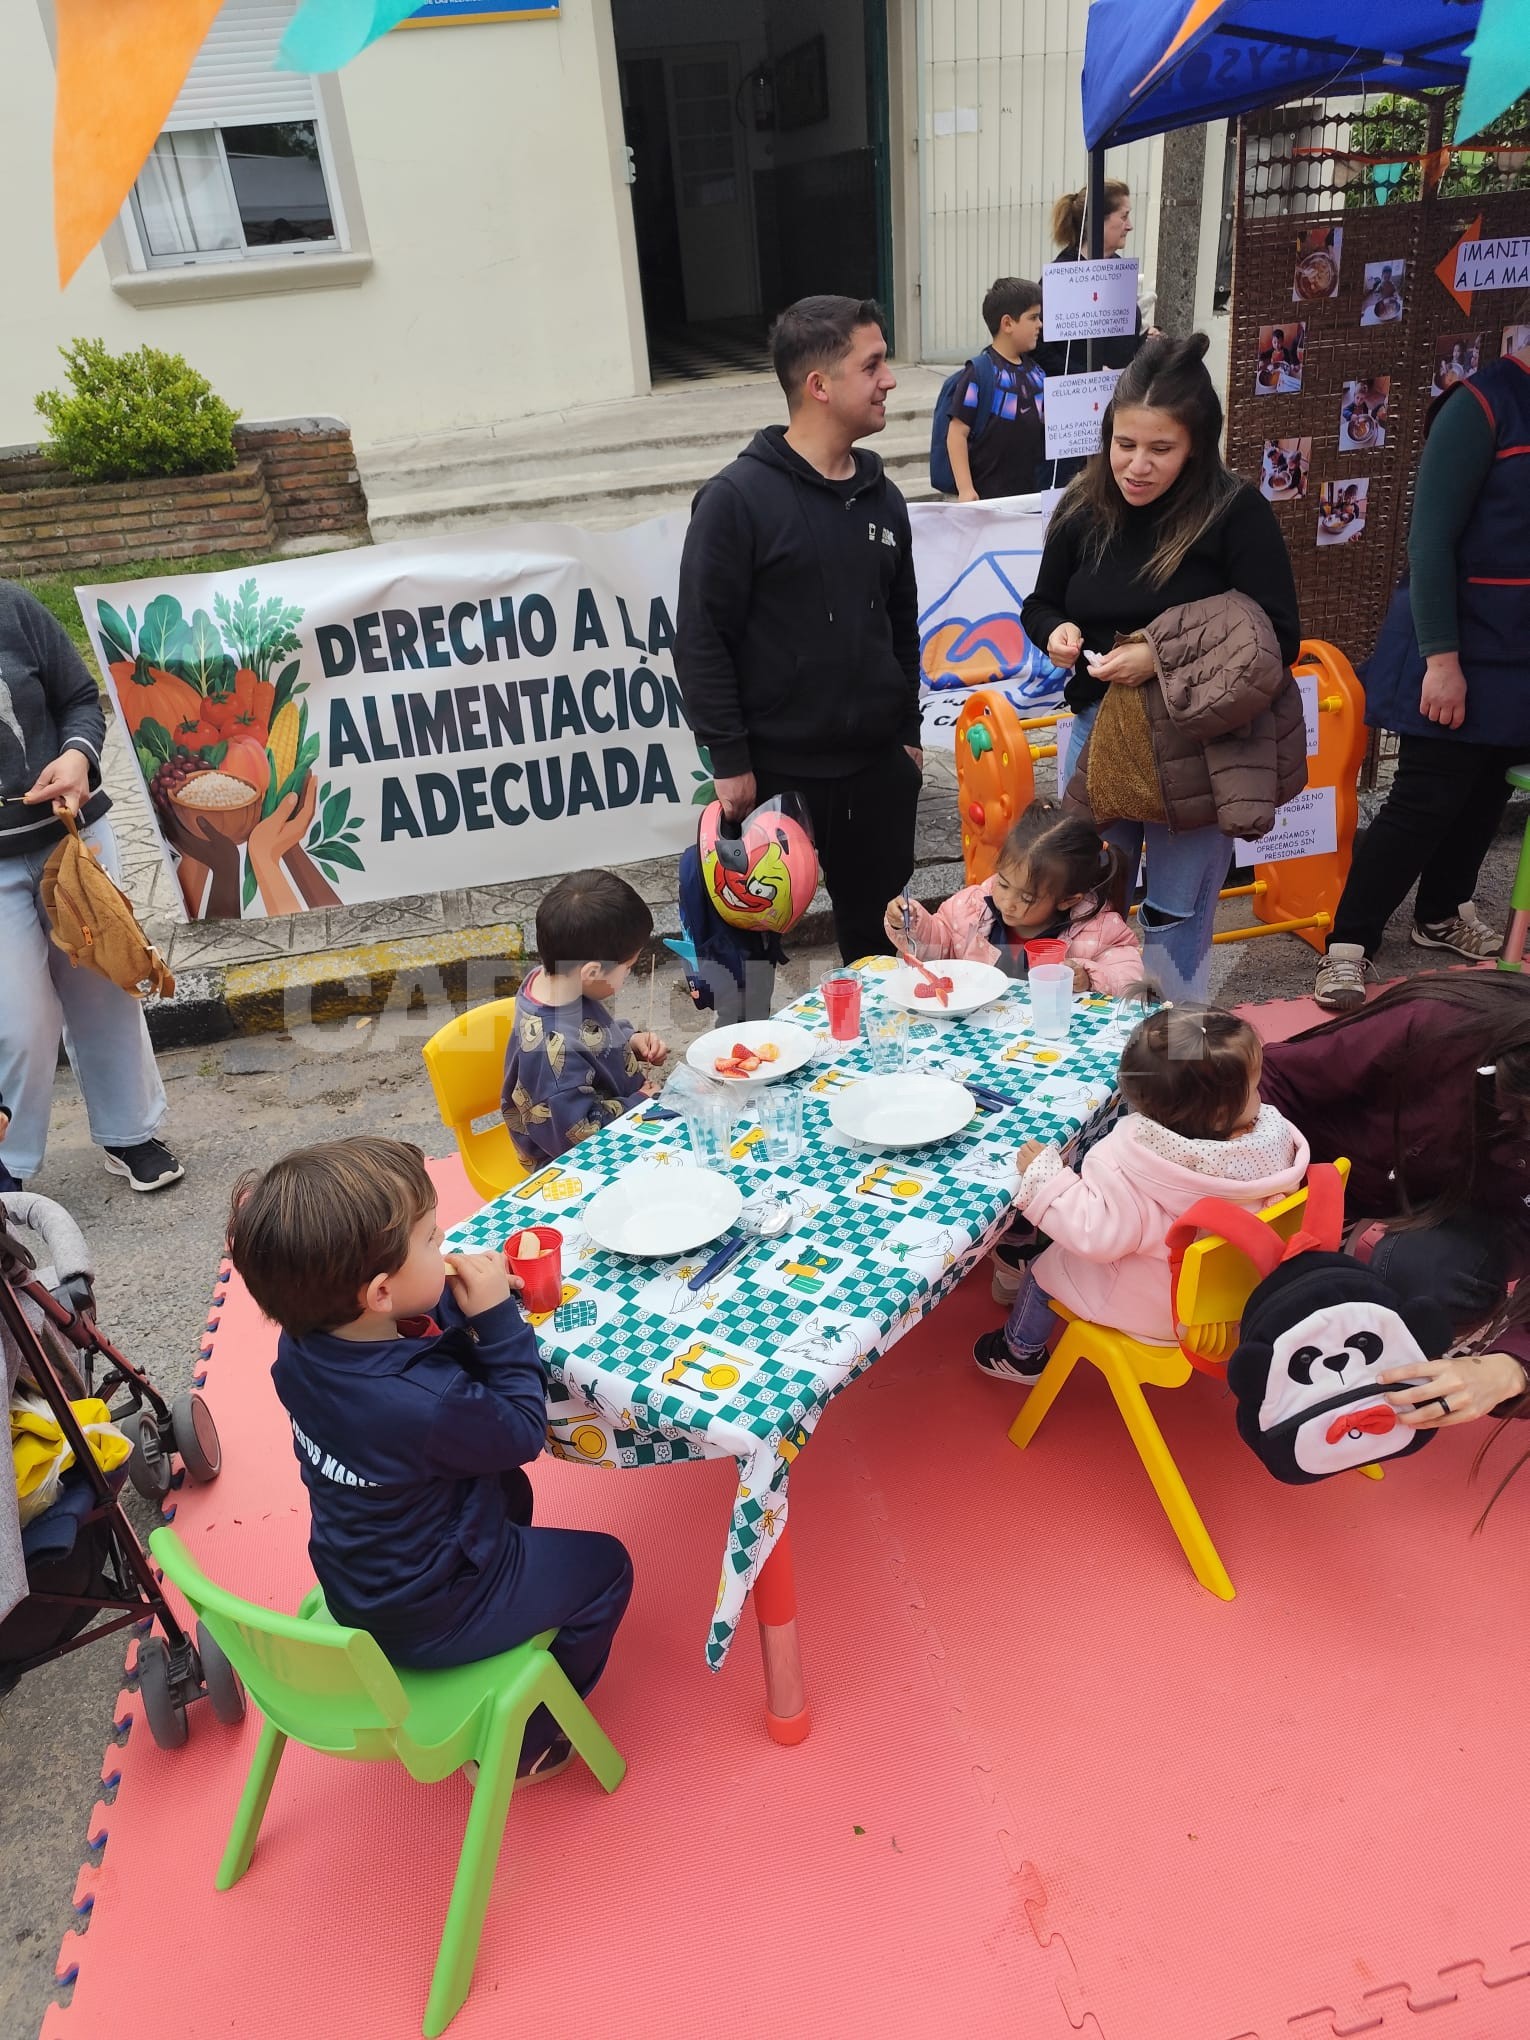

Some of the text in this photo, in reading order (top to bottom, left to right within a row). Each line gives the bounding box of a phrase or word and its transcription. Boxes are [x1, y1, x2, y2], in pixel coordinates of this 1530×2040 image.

[1092, 264, 1114, 273] COMER
[1115, 263, 1138, 271] MIRANDO
[1075, 275, 1089, 283] LOS
[1456, 271, 1467, 288] A
[1473, 269, 1496, 288] LA
[1066, 311, 1080, 320] LOS
[1082, 309, 1111, 319] ADULTOS
[1112, 308, 1130, 317] SOMOS
[1056, 317, 1129, 329] MODELOS IMPORTANTES
[1060, 329, 1077, 337] PARA
[1078, 327, 1101, 336] NIÑOS
[1088, 376, 1110, 384] MEJOR
[1052, 387, 1080, 397] CELULAR
[1082, 386, 1088, 394] O
[1061, 422, 1073, 430] LAS
[1059, 431, 1071, 439] LAS
[315, 587, 677, 679] DERECHO A LA
[328, 655, 695, 768] ALIMENTACIÓN
[380, 742, 681, 842] ADECUADA
[1311, 792, 1324, 801] NO
[1256, 838, 1315, 853] OFRECEMOS SIN
